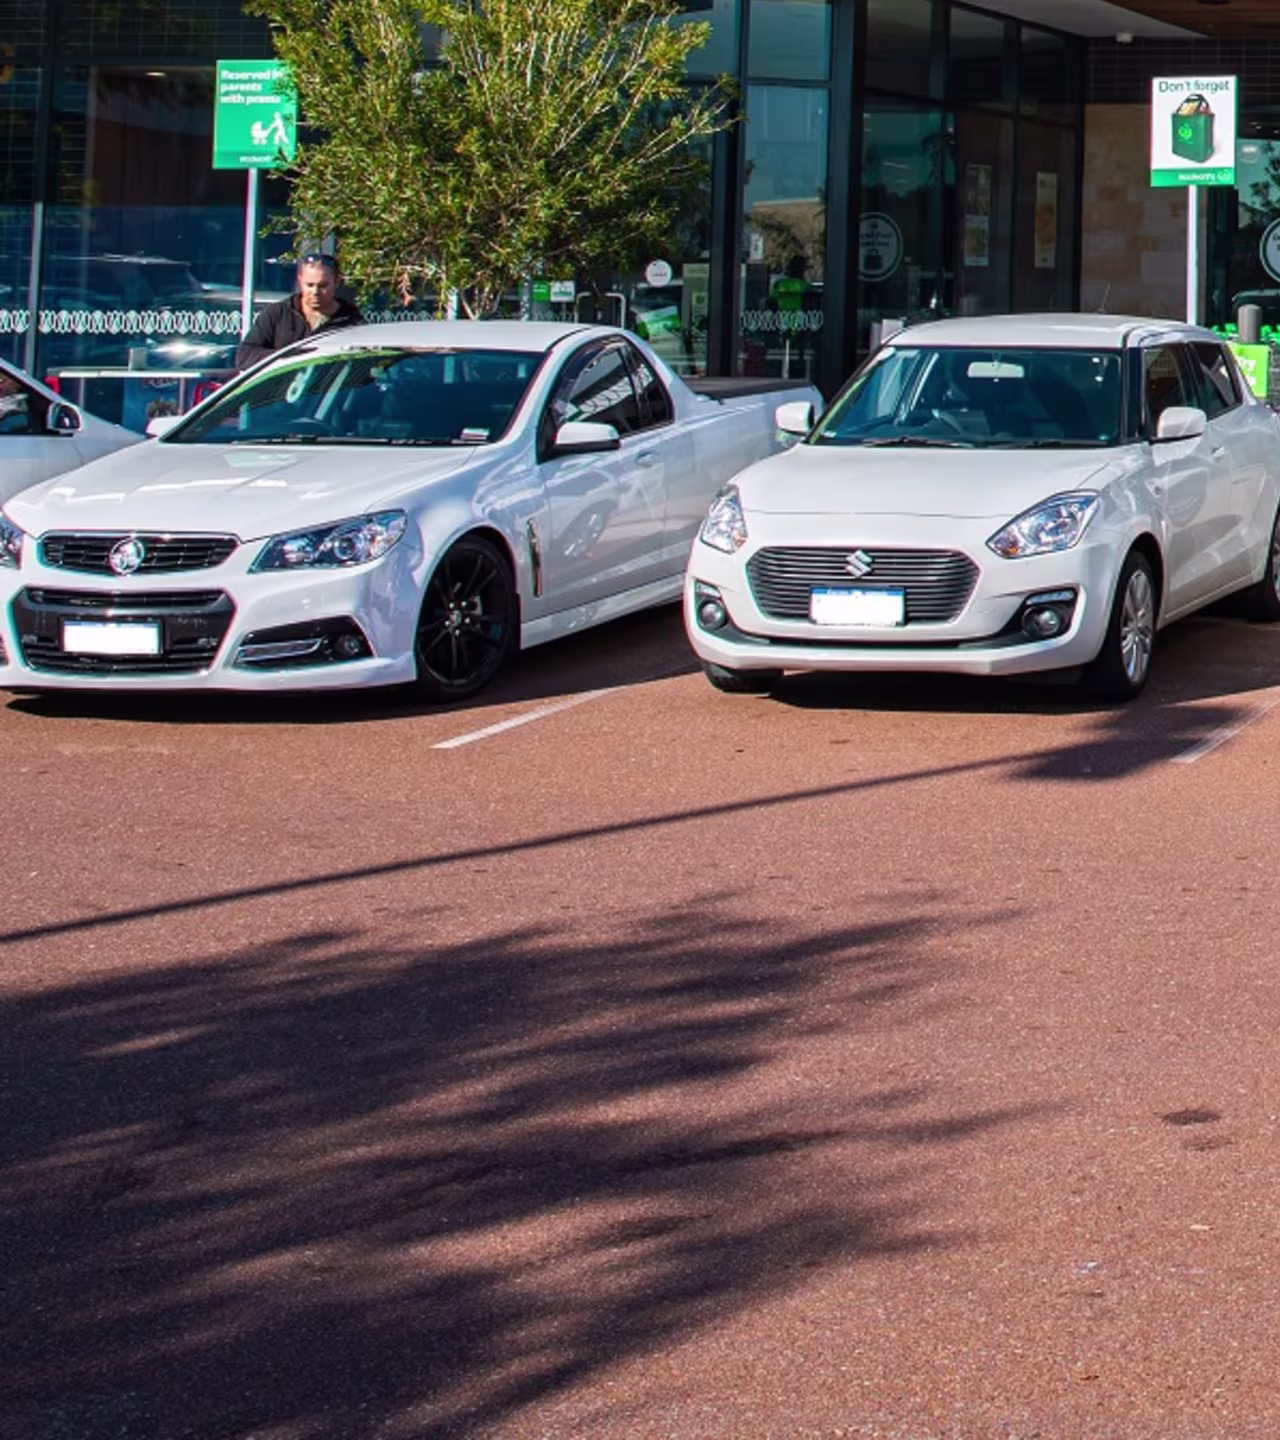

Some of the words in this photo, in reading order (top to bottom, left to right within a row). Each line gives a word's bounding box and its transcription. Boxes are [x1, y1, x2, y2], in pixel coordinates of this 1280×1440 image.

[221, 70, 272, 80] Reserved
[220, 83, 262, 94] parents
[1158, 81, 1190, 93] Don't
[1193, 80, 1229, 95] forget
[220, 93, 245, 104] with
